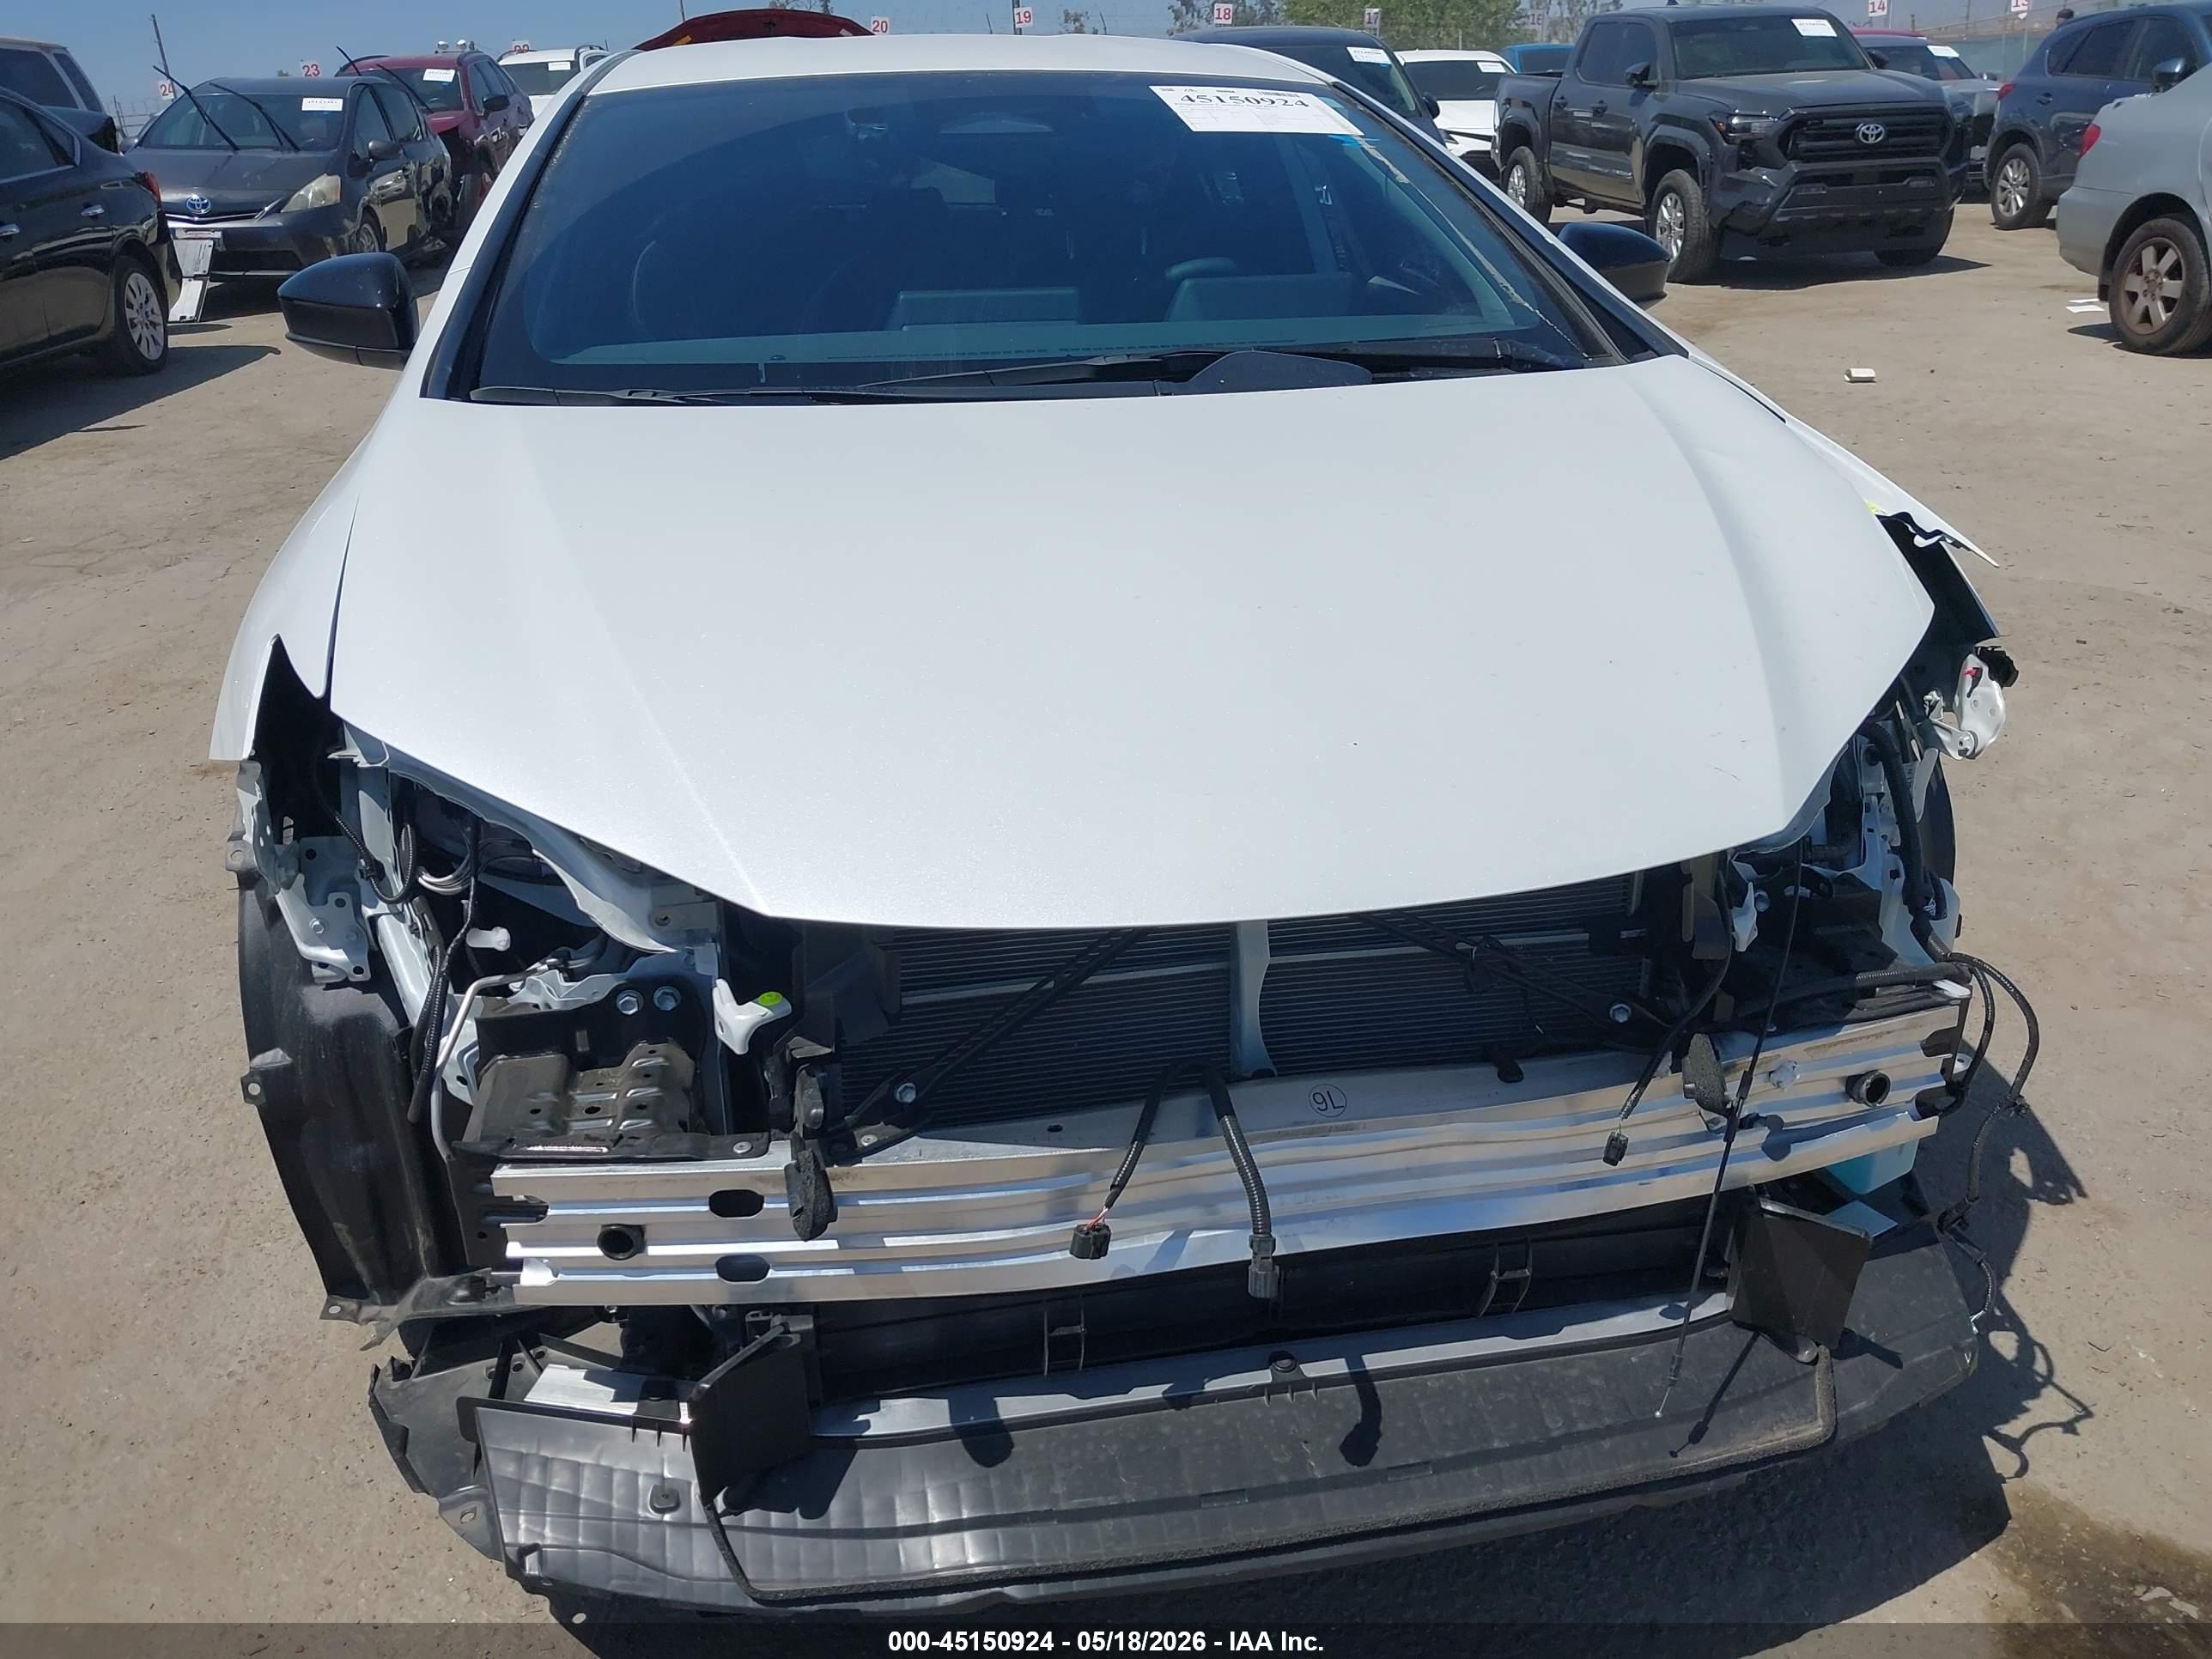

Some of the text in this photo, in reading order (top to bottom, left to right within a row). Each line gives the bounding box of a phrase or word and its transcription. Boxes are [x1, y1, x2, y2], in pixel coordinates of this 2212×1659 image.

[1215, 7, 1231, 21] 18
[1869, 0, 1887, 14] 14
[1015, 10, 1032, 25] 19
[1365, 11, 1380, 25] 17
[872, 19, 889, 33] 20
[301, 64, 321, 77] 23
[160, 82, 175, 97] 24
[1180, 94, 1310, 108] 45150924
[1312, 1090, 1345, 1112] 9L
